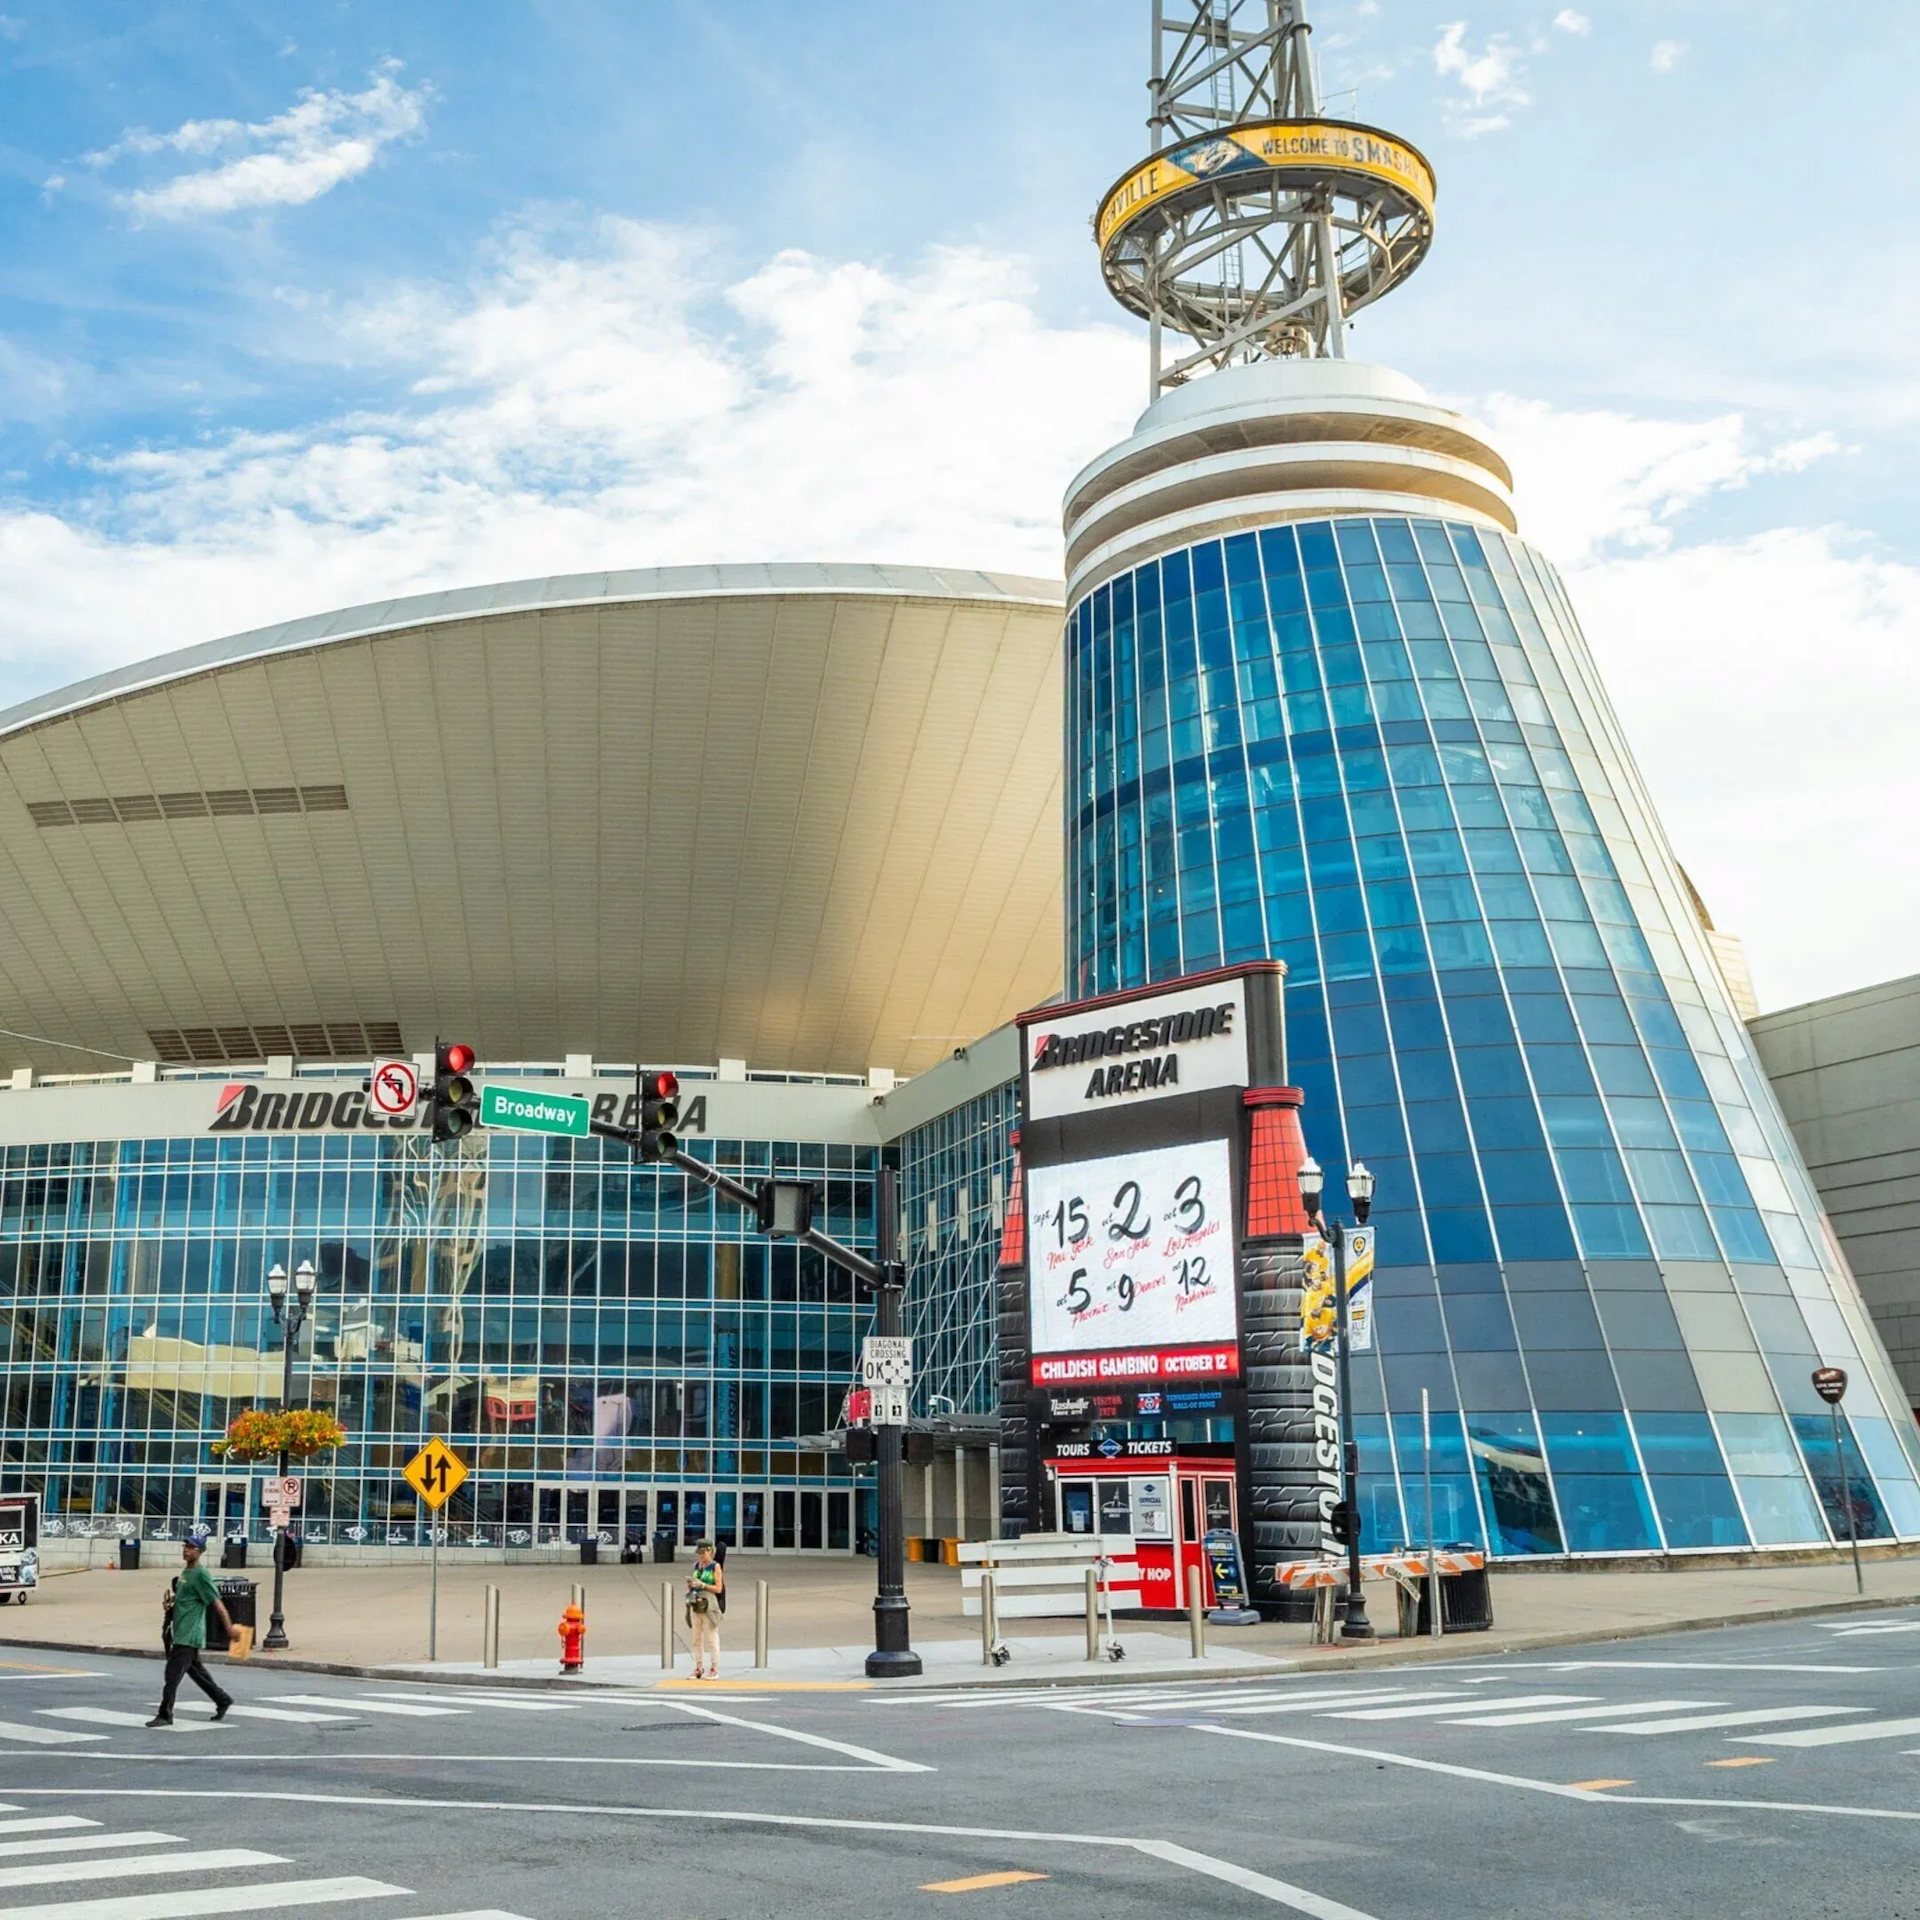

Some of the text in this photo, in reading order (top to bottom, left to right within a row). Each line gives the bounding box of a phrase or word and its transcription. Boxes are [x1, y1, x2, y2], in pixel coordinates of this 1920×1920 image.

[1262, 138, 1328, 155] WELCOME
[1335, 140, 1348, 157] TO
[1031, 1002, 1235, 1072] BRIDGESTONE
[1084, 1054, 1179, 1099] ARENA
[495, 1095, 576, 1127] Broadway
[1108, 1180, 1151, 1241] 2
[1174, 1176, 1205, 1235] 3
[1051, 1196, 1090, 1248] 15
[1177, 1256, 1211, 1295] 12
[1067, 1268, 1091, 1314] 5
[1118, 1273, 1135, 1311] 9
[1134, 1275, 1166, 1297] Denver
[869, 1340, 906, 1349] DIAGONAL
[871, 1349, 906, 1358] CROSSING
[866, 1362, 884, 1379] OK
[1040, 1354, 1227, 1380] CHILDISH GAMBINO OCTOBER 12
[1056, 1441, 1172, 1456] TOURS TICKETS
[0, 1533, 20, 1544] KA
[1147, 1568, 1171, 1581] HOP
[1386, 1566, 1402, 1579] ROAD
